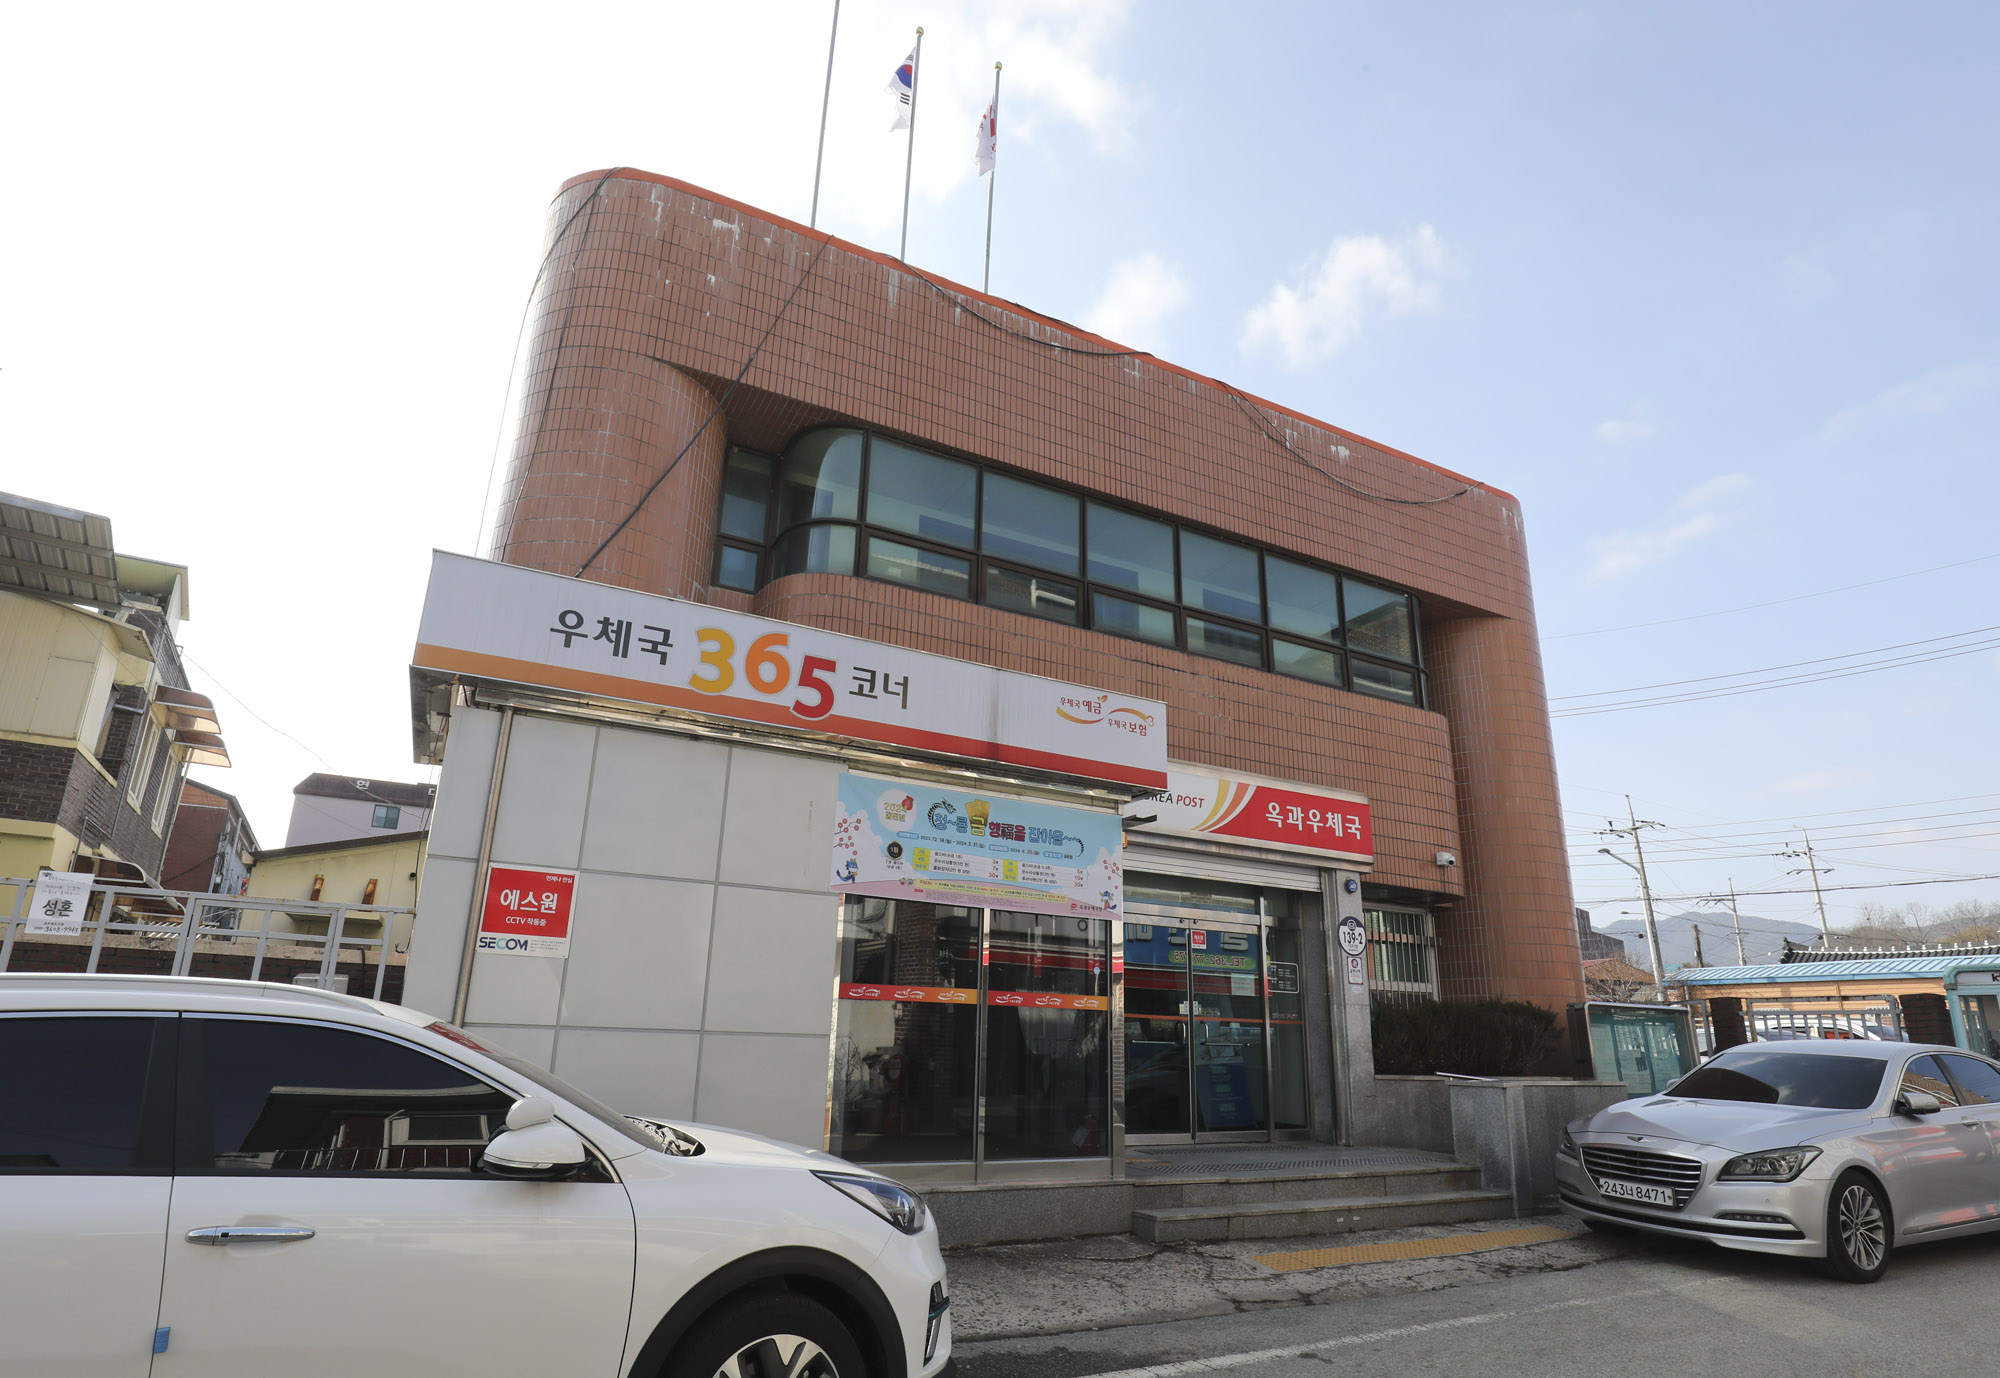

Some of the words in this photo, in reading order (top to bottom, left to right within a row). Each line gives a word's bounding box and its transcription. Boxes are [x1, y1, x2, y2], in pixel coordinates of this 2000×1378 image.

[550, 609, 674, 665] 우체국
[690, 627, 837, 721] 365
[849, 667, 910, 710] 코너
[1060, 696, 1081, 709] 우체국
[1082, 700, 1102, 715] 예금
[1107, 718, 1127, 730] 우체국
[1128, 721, 1147, 737] 보험
[883, 802, 908, 814] 2024
[1176, 794, 1205, 809] POST
[971, 816, 986, 837] 금
[1265, 802, 1362, 840] 옥과우체국
[42, 899, 73, 917] 성혼
[500, 889, 558, 914] 에스원
[505, 916, 526, 925] CCTV
[527, 918, 547, 927] 작동중
[479, 936, 529, 951] SECOM
[1343, 931, 1363, 945] 139-2
[1636, 1186, 1667, 1203] 8471
